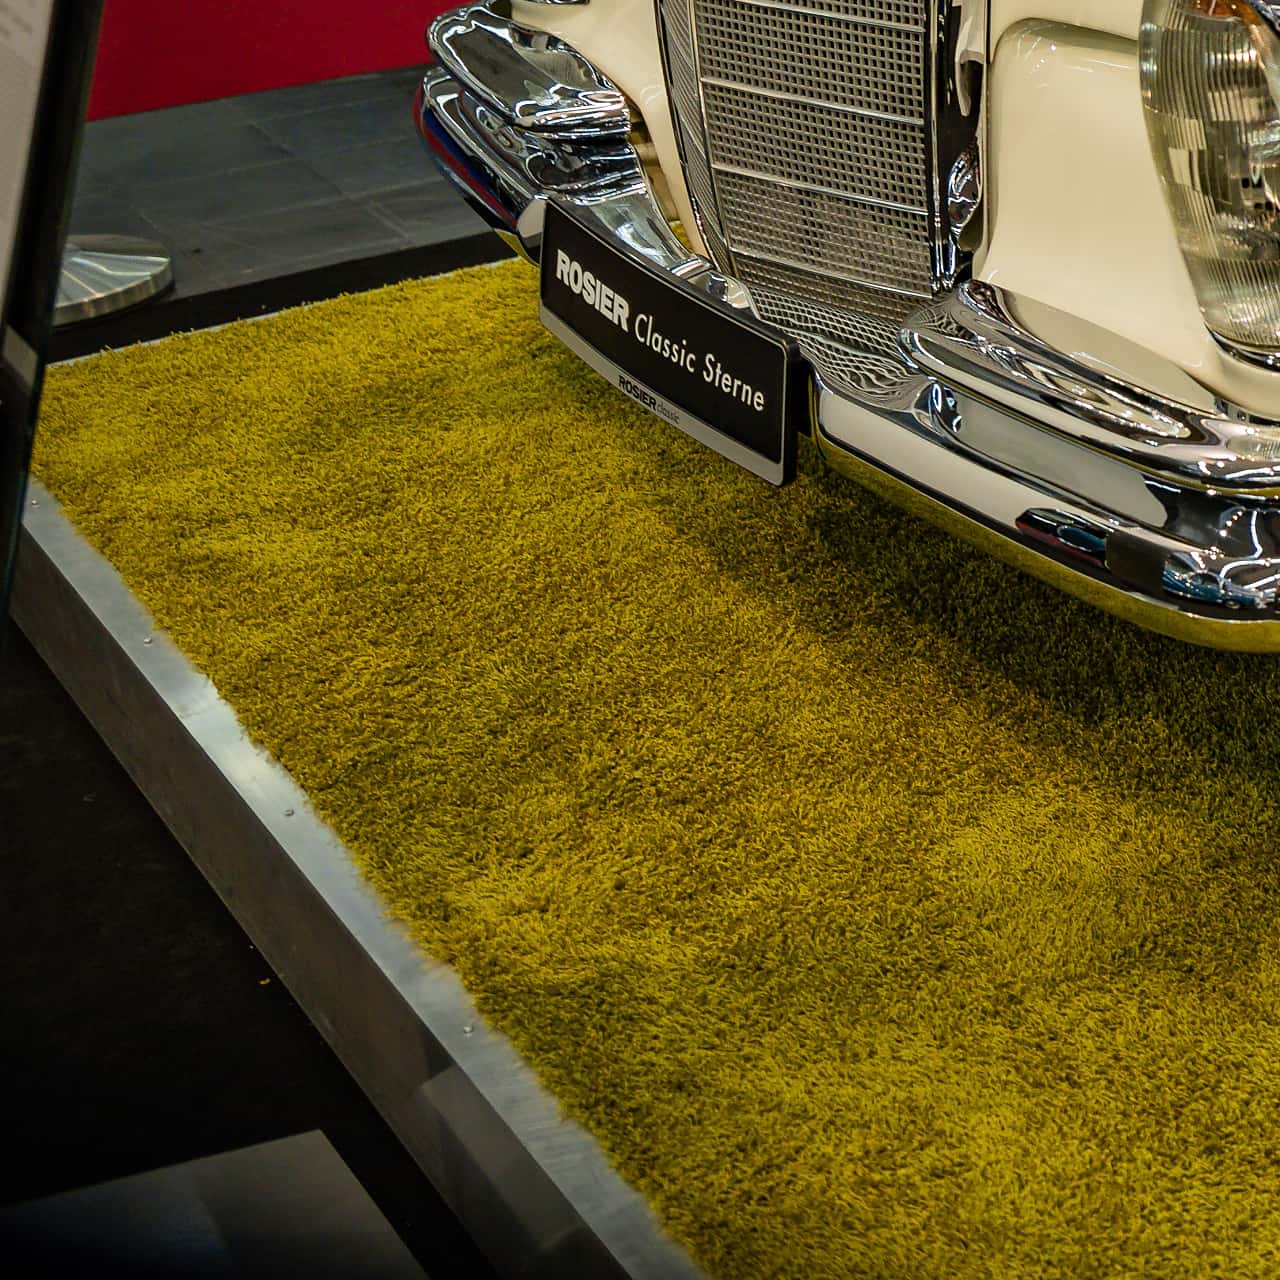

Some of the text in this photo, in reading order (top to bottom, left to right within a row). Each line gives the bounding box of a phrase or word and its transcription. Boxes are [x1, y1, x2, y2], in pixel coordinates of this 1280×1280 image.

[556, 249, 766, 412] ROSIER Classic Sterne
[618, 374, 658, 413] ROSIER
